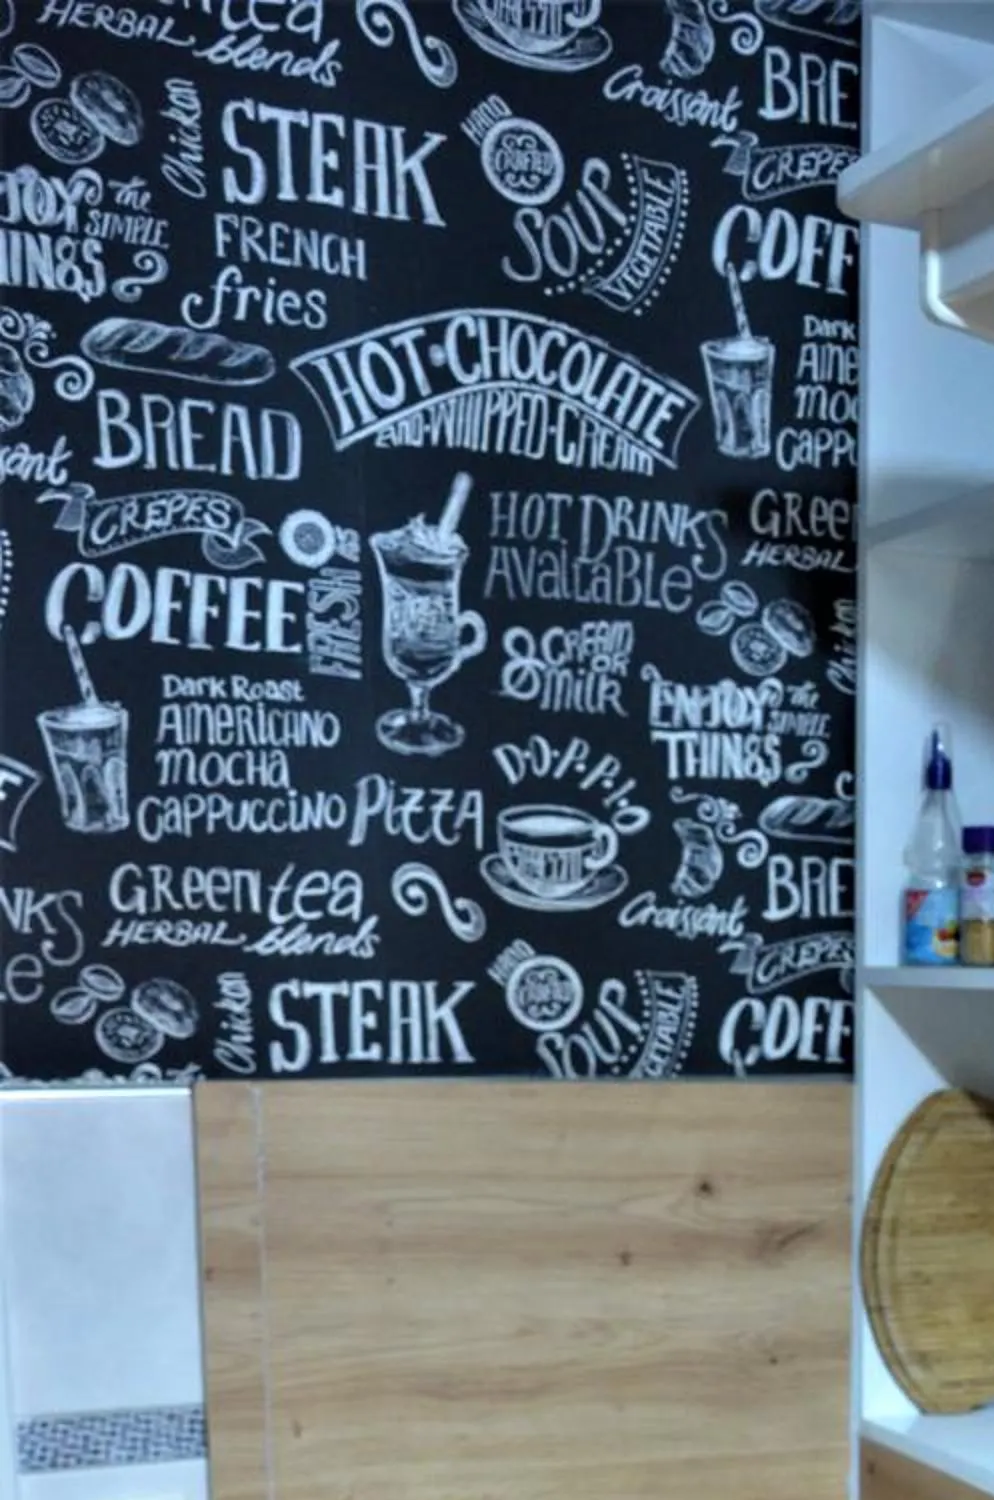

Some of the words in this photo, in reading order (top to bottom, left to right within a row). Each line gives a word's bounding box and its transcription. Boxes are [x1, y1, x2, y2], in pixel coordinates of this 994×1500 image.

[193, 34, 344, 87] blends
[603, 64, 743, 131] Croissant
[160, 77, 207, 199] Chicken
[222, 98, 448, 228] STEAK
[84, 209, 171, 250] SIMPLE
[107, 176, 152, 214] the
[502, 157, 628, 283] SOUP
[214, 213, 368, 281] FRENCH
[602, 167, 678, 301] VEGETABLE
[181, 266, 328, 330] fries
[309, 328, 433, 434] HOT
[446, 315, 686, 450] CHOCOLATE
[93, 389, 303, 481] BREAD
[90, 496, 232, 546] CREPES
[489, 491, 572, 541] HOT
[579, 495, 730, 581] DRINKS
[45, 562, 306, 653] COFFEE
[306, 567, 364, 681] FRESH
[162, 674, 226, 701] Dark
[232, 676, 305, 702] Roast
[640, 663, 784, 734] ENJOY
[650, 730, 782, 787] THINGS
[267, 862, 364, 924] tea
[617, 890, 751, 941] Croissant
[102, 919, 248, 948] HERBAL
[243, 916, 382, 959] blends
[213, 971, 258, 1074] Chicken
[268, 978, 477, 1073] STEAK
